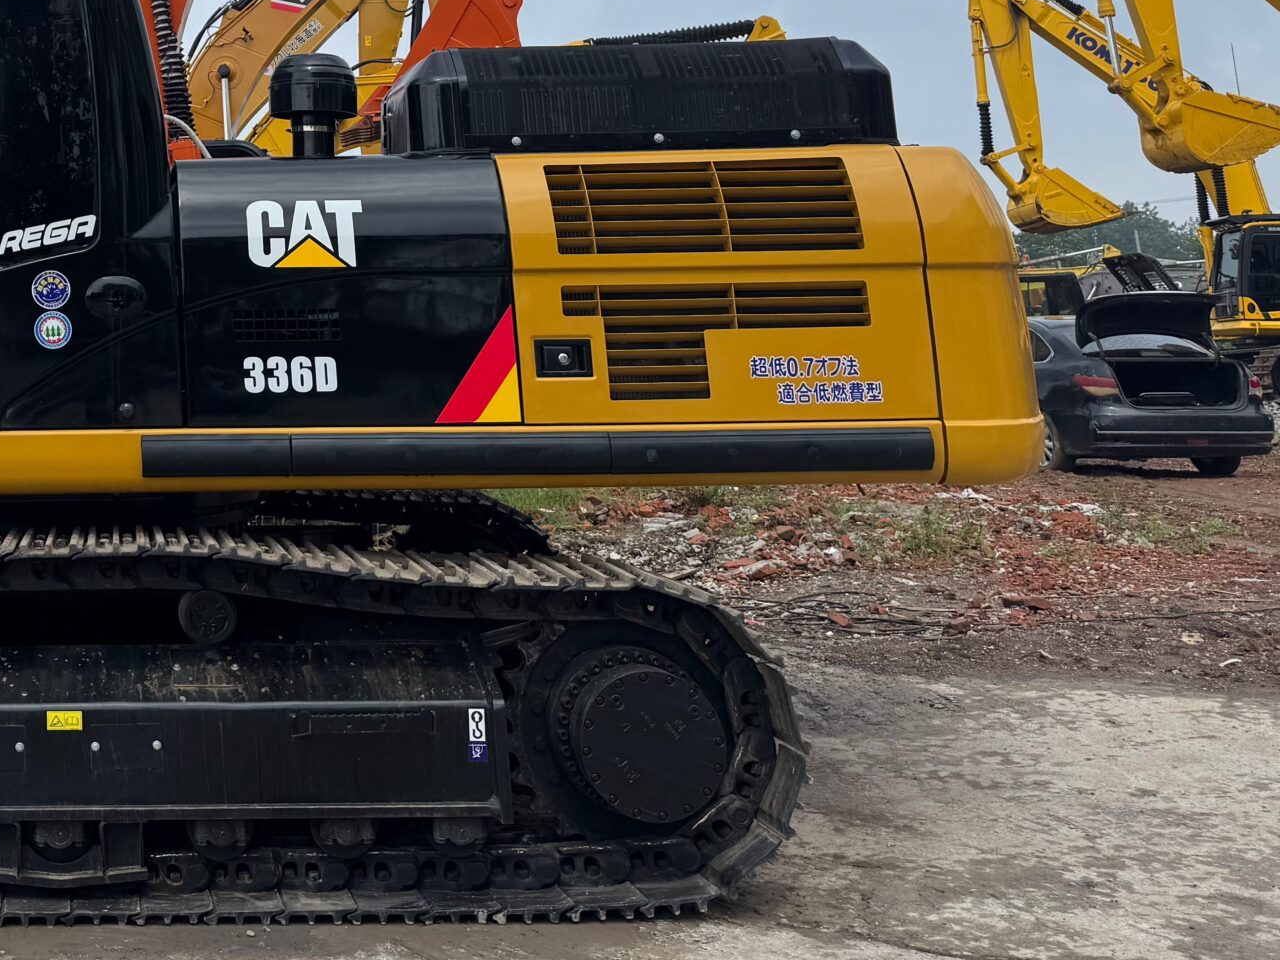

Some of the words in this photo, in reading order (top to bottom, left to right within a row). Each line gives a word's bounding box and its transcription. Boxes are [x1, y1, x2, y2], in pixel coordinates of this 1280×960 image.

[246, 199, 363, 268] CAT
[243, 356, 339, 394] 336D
[750, 356, 860, 378] 超低0.7オフ法
[777, 381, 884, 404] 適合低燃費型
